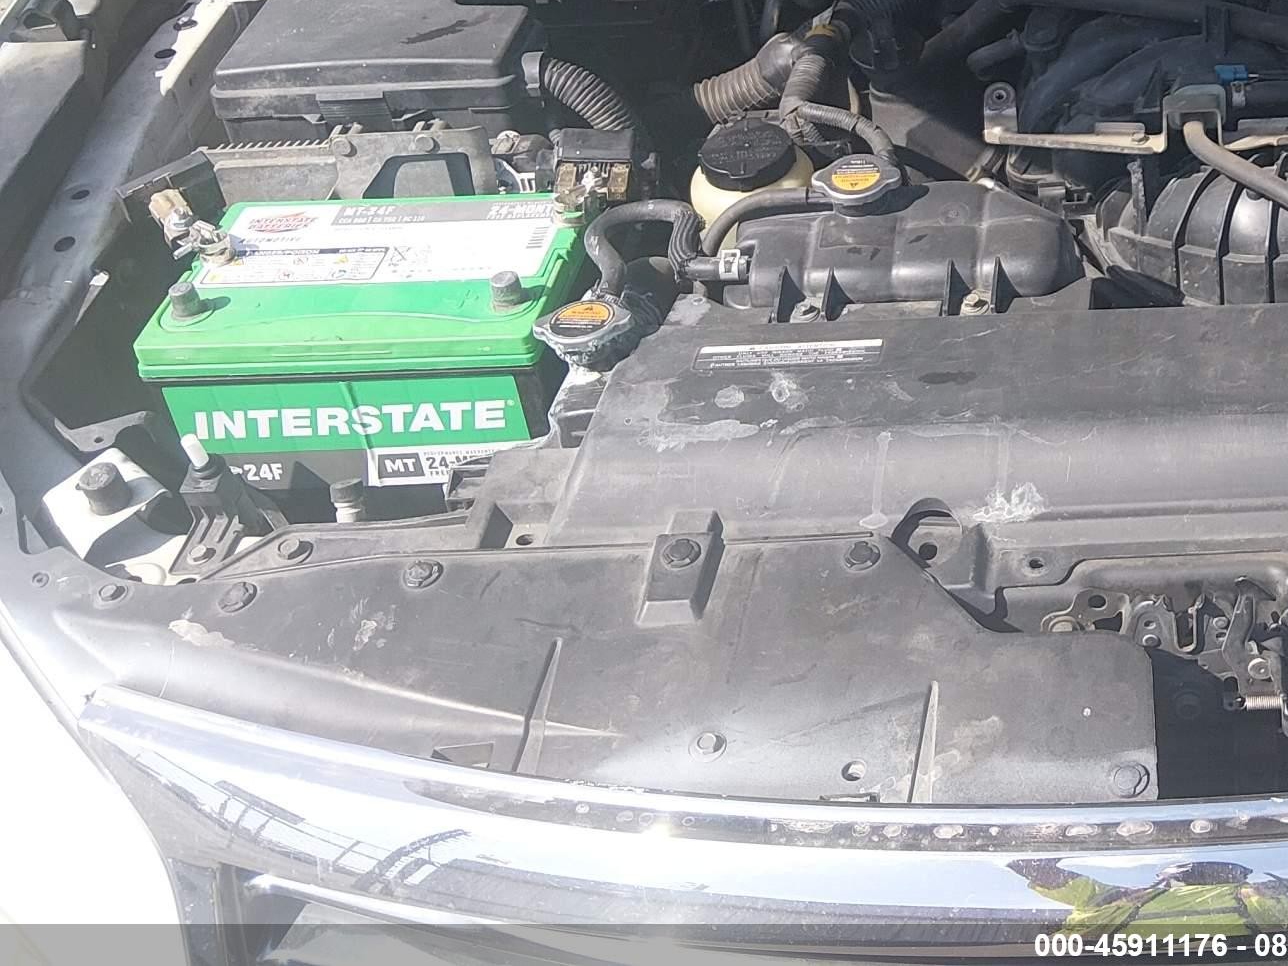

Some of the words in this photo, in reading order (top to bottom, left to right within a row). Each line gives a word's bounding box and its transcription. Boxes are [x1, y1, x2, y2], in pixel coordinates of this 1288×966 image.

[490, 204, 553, 215] 24-MONT
[194, 399, 506, 440] INTERSTATE
[384, 457, 416, 473] MT
